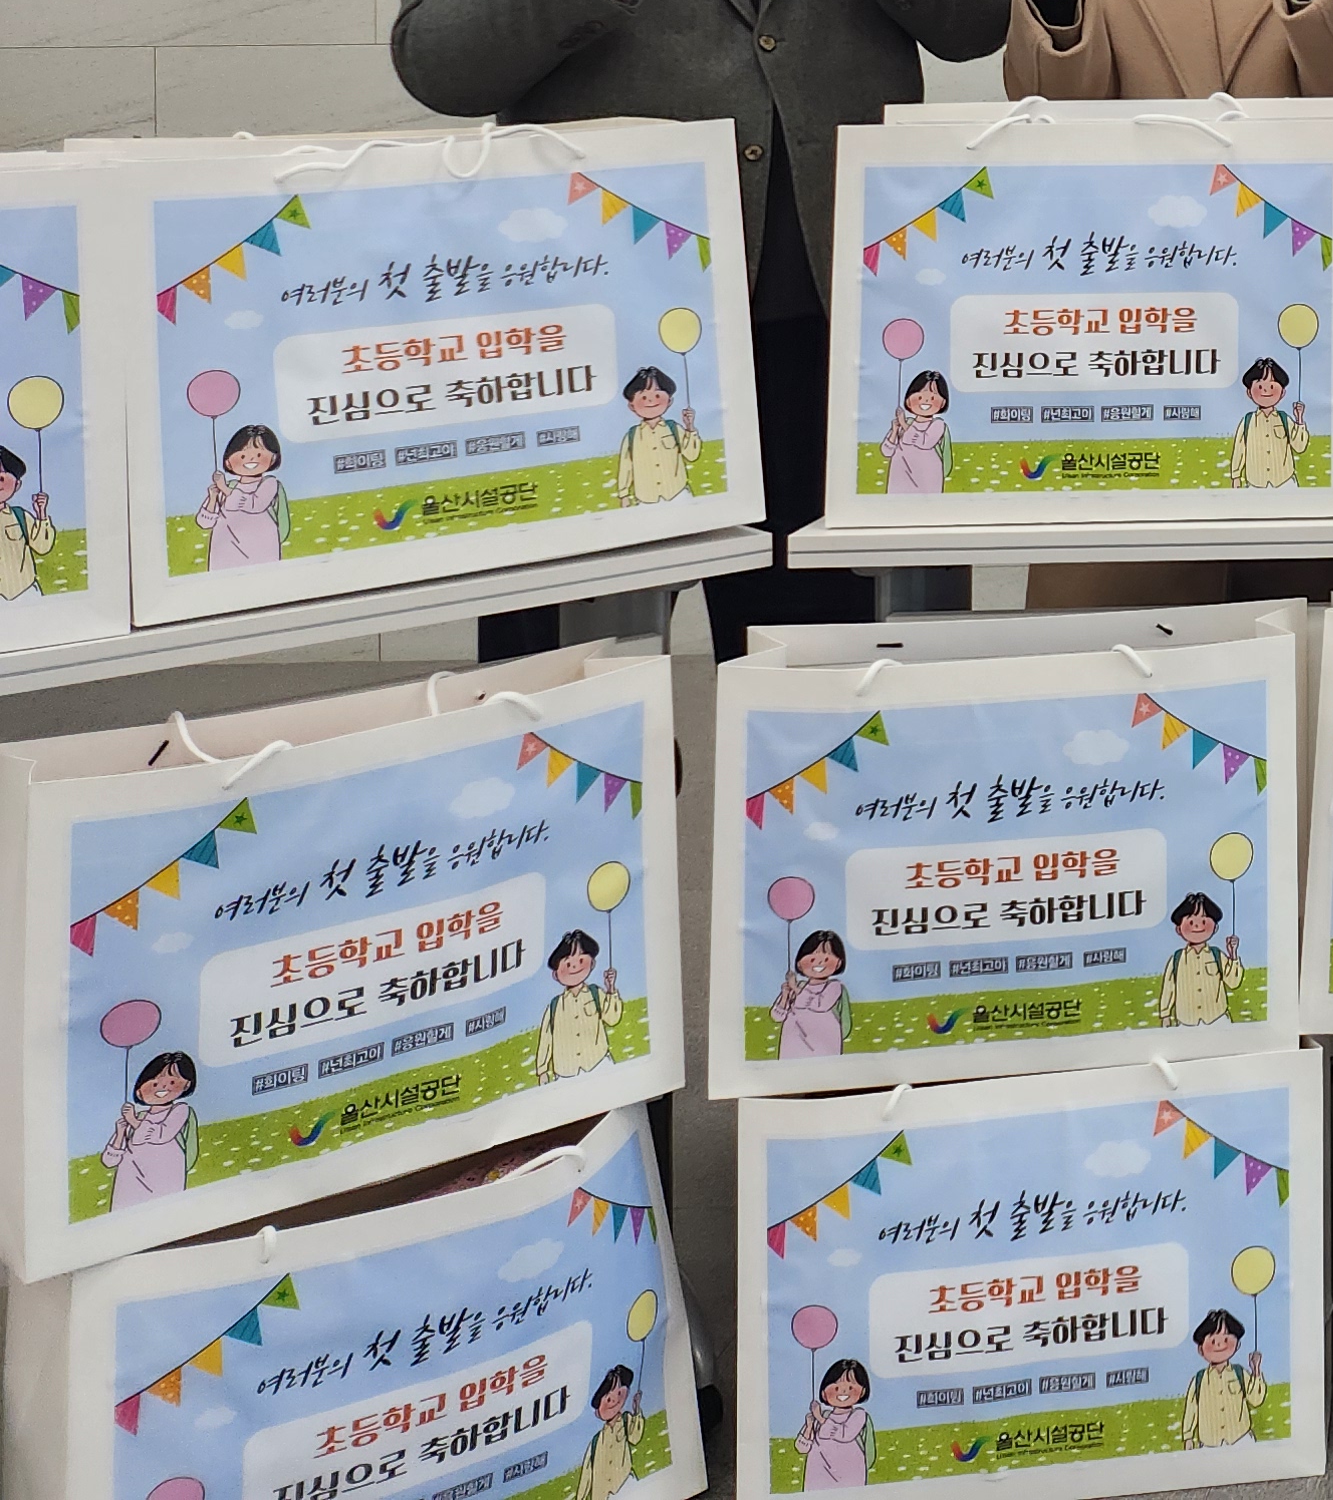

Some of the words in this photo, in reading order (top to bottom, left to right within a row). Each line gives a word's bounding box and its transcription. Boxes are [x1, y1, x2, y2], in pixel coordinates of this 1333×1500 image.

[1004, 309, 1110, 335] 초등학교
[1119, 307, 1197, 334] 입학을
[342, 336, 468, 374] 초등학교
[477, 324, 566, 360] 입학을
[972, 352, 1079, 378] 진심으로
[1088, 349, 1221, 376] 축하합니다
[306, 385, 436, 426] 진심으로
[445, 364, 596, 407] 축하합니다
[1061, 451, 1161, 471] 울산시설공단
[421, 480, 538, 517] 울산시설공단
[214, 880, 310, 920] 여러분의
[319, 858, 355, 901] 첫
[366, 839, 441, 898] 출발을
[905, 858, 1024, 889] 초등학교
[1034, 849, 1120, 881] 입학을
[871, 904, 991, 937] 진심으로
[999, 889, 1146, 926] 축하합니다
[271, 930, 405, 988] 초등학교
[417, 903, 504, 952] 입학을
[229, 987, 367, 1049] 진심으로
[378, 940, 528, 1005] 축하합니다
[972, 998, 1082, 1024] 울산시설공단
[340, 1071, 461, 1127] 울산시설공단
[878, 1214, 960, 1244] 여러분의
[969, 1199, 1000, 1239] 첫
[1010, 1190, 1078, 1241] 출발을
[929, 1277, 1046, 1313] 초등학교
[1056, 1264, 1142, 1300] 입학을
[895, 1325, 1014, 1363] 진심으로
[1023, 1306, 1169, 1347] 축하합니다
[315, 1393, 447, 1457] 초등학교
[459, 1360, 548, 1412] 입학을
[418, 1394, 572, 1463] 축하합니다
[996, 1420, 1105, 1452] 울산시설공단
